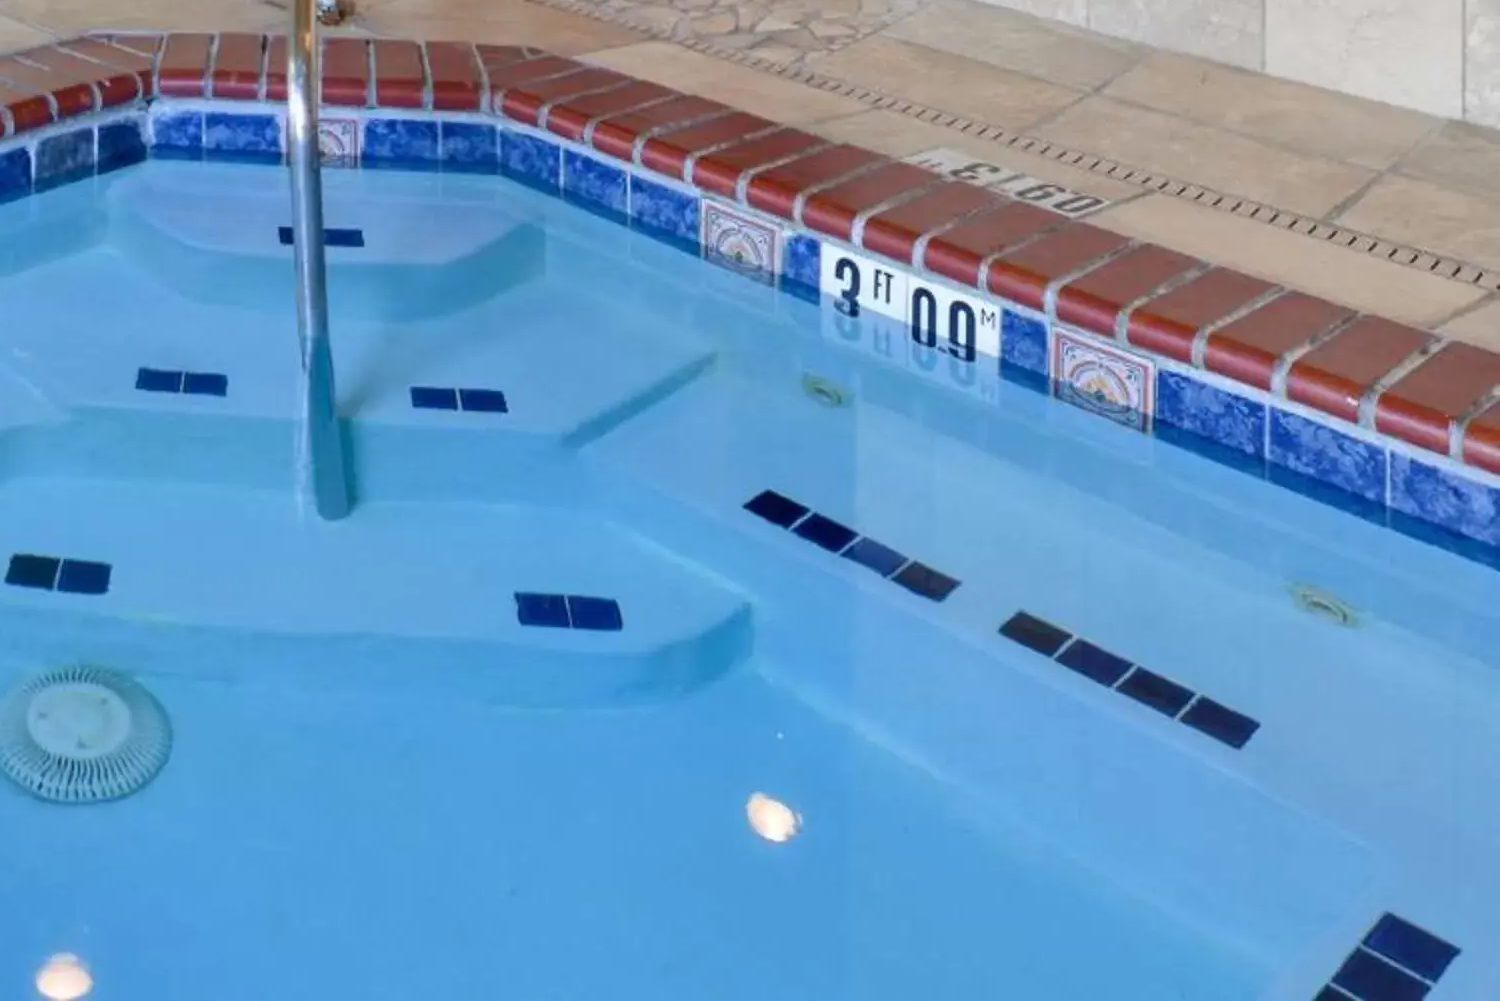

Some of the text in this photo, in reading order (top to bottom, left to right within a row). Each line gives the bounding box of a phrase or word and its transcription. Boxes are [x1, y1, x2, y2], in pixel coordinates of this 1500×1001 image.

[834, 256, 861, 318] 3
[872, 267, 896, 306] FT
[980, 307, 997, 330] M
